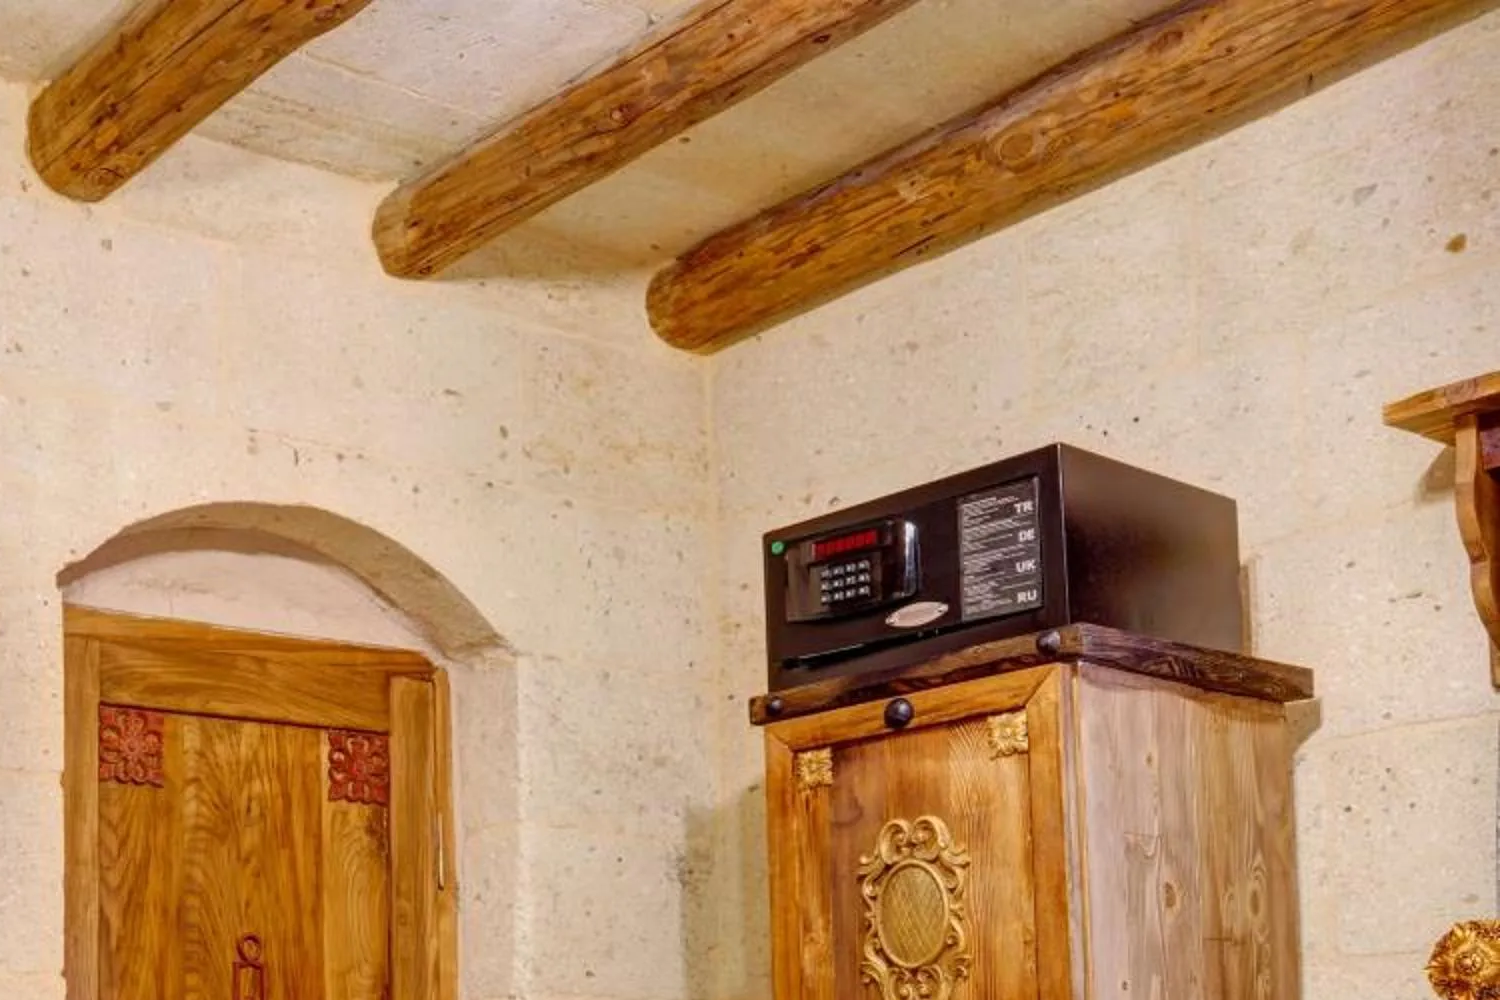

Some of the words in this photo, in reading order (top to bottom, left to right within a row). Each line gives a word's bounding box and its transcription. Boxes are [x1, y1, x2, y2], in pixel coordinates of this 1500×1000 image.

[1013, 501, 1034, 513] TR
[1018, 528, 1036, 542] DE
[1015, 560, 1037, 573] UK
[1016, 589, 1037, 603] RU
